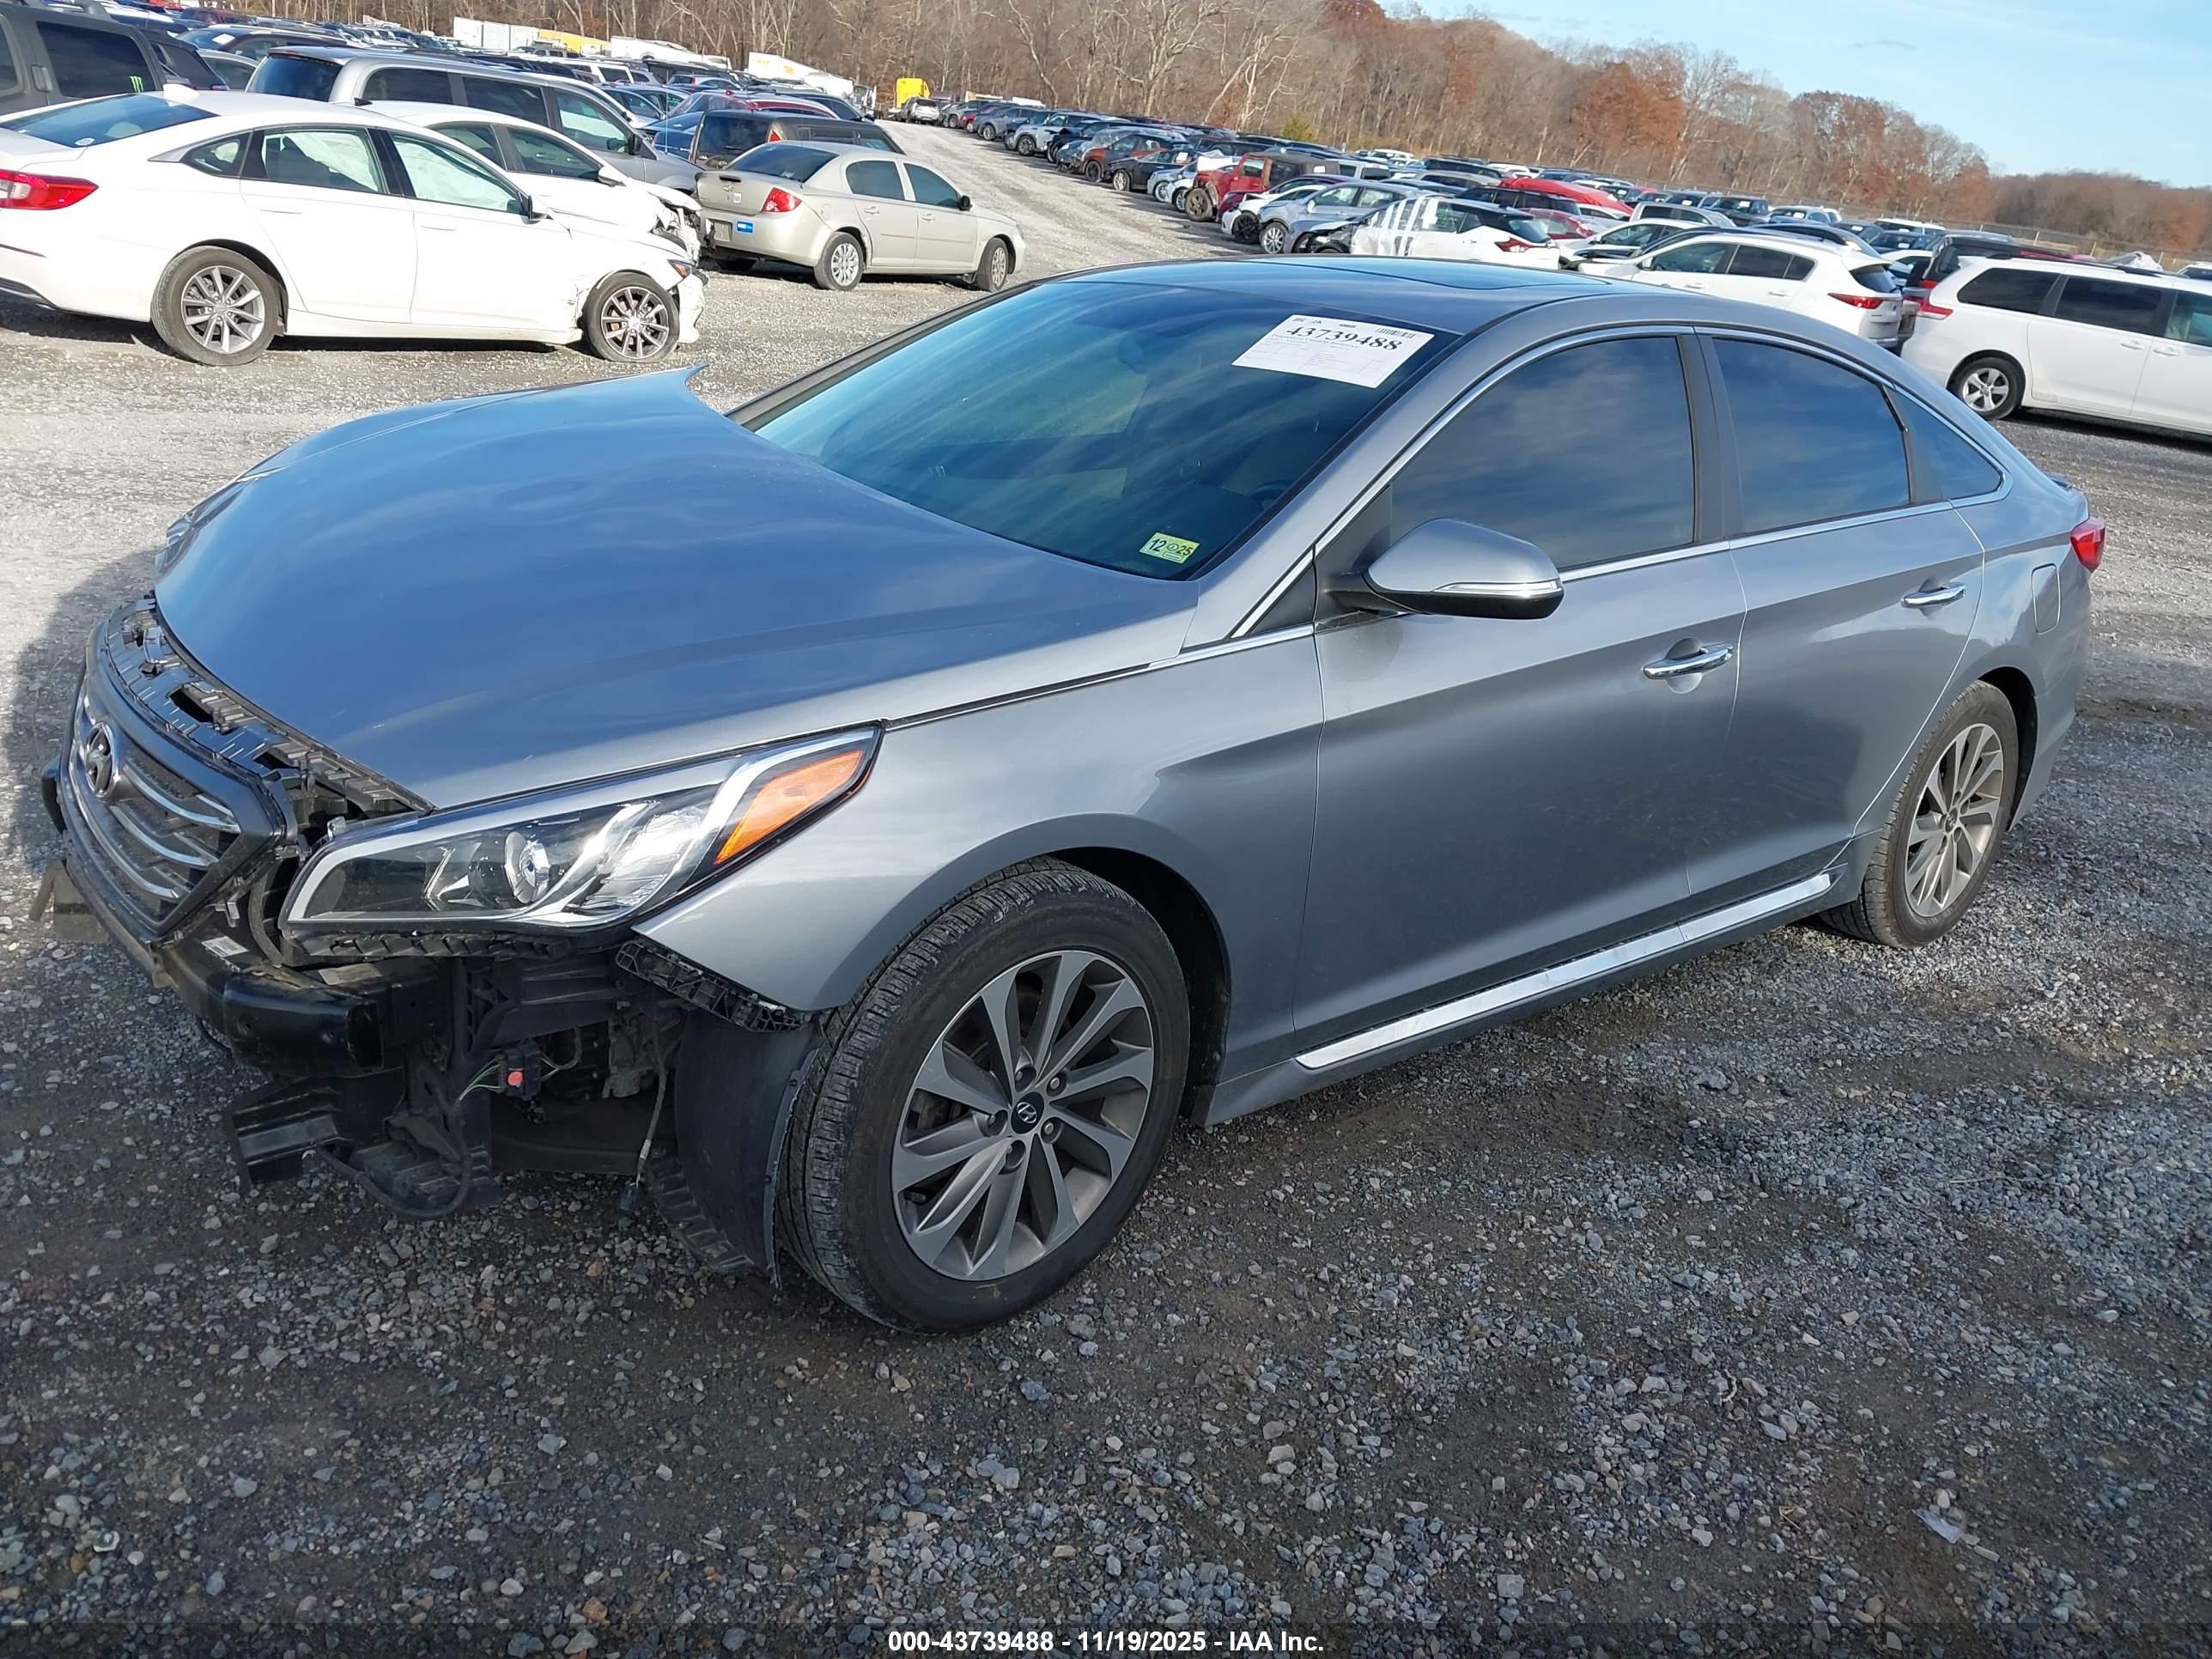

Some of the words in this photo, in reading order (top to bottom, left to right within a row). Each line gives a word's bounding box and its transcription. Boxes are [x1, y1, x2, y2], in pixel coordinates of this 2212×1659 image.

[1286, 325, 1402, 350] 43739488
[1149, 538, 1167, 552] 12
[1176, 544, 1194, 556] 25
